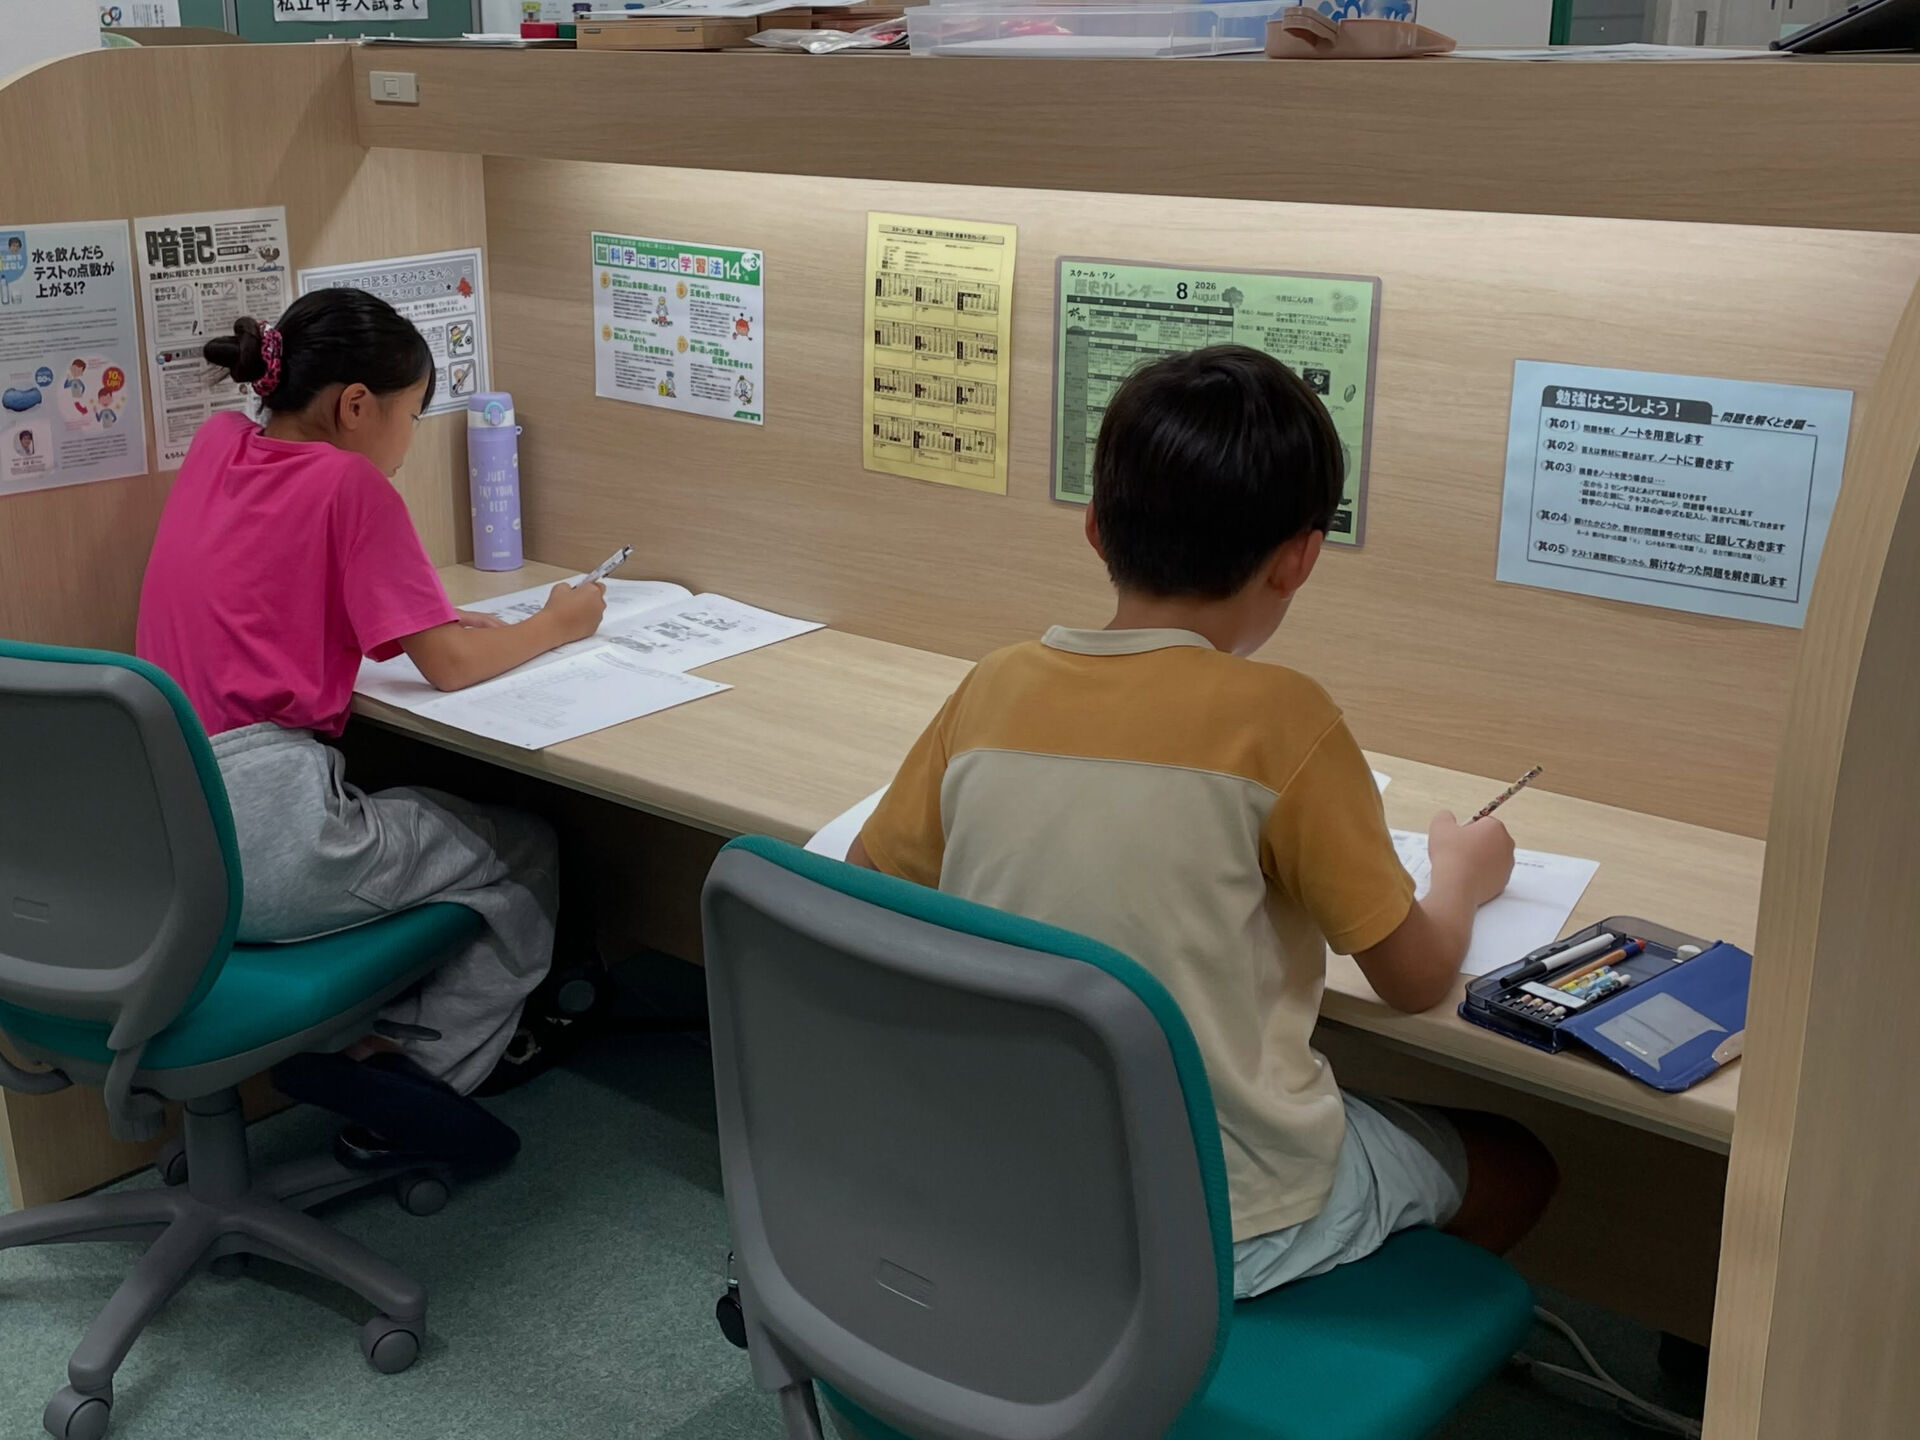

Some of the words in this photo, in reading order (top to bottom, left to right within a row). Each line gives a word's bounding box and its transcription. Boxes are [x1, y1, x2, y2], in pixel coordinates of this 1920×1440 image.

[32, 245, 104, 263] 水を飲んだら
[145, 226, 215, 268] 暗記
[34, 261, 114, 281] テストの点数が
[1070, 269, 1116, 279] スクール・ワン
[35, 281, 86, 298] 上がる!?
[376, 283, 446, 298] ナーを守りましょう
[1074, 278, 1166, 298] 歴史カレンダー
[1176, 282, 1188, 300] 8
[1195, 281, 1217, 290] 2026
[1192, 289, 1221, 303] August
[1555, 389, 1681, 418] 勉強はこうしよう！
[1549, 418, 1576, 430] 其の1
[1620, 427, 1704, 445] ノートを用意します
[1547, 439, 1574, 451] 其の2
[1545, 460, 1573, 473] 其の3
[486, 470, 507, 482] JUST
[479, 485, 492, 499] TRY
[495, 485, 514, 497] YOUR
[489, 500, 508, 512] BEST
[1541, 509, 1568, 522] 其の4
[1704, 533, 1786, 554] 記録しておきます
[1538, 540, 1566, 554] 其の5
